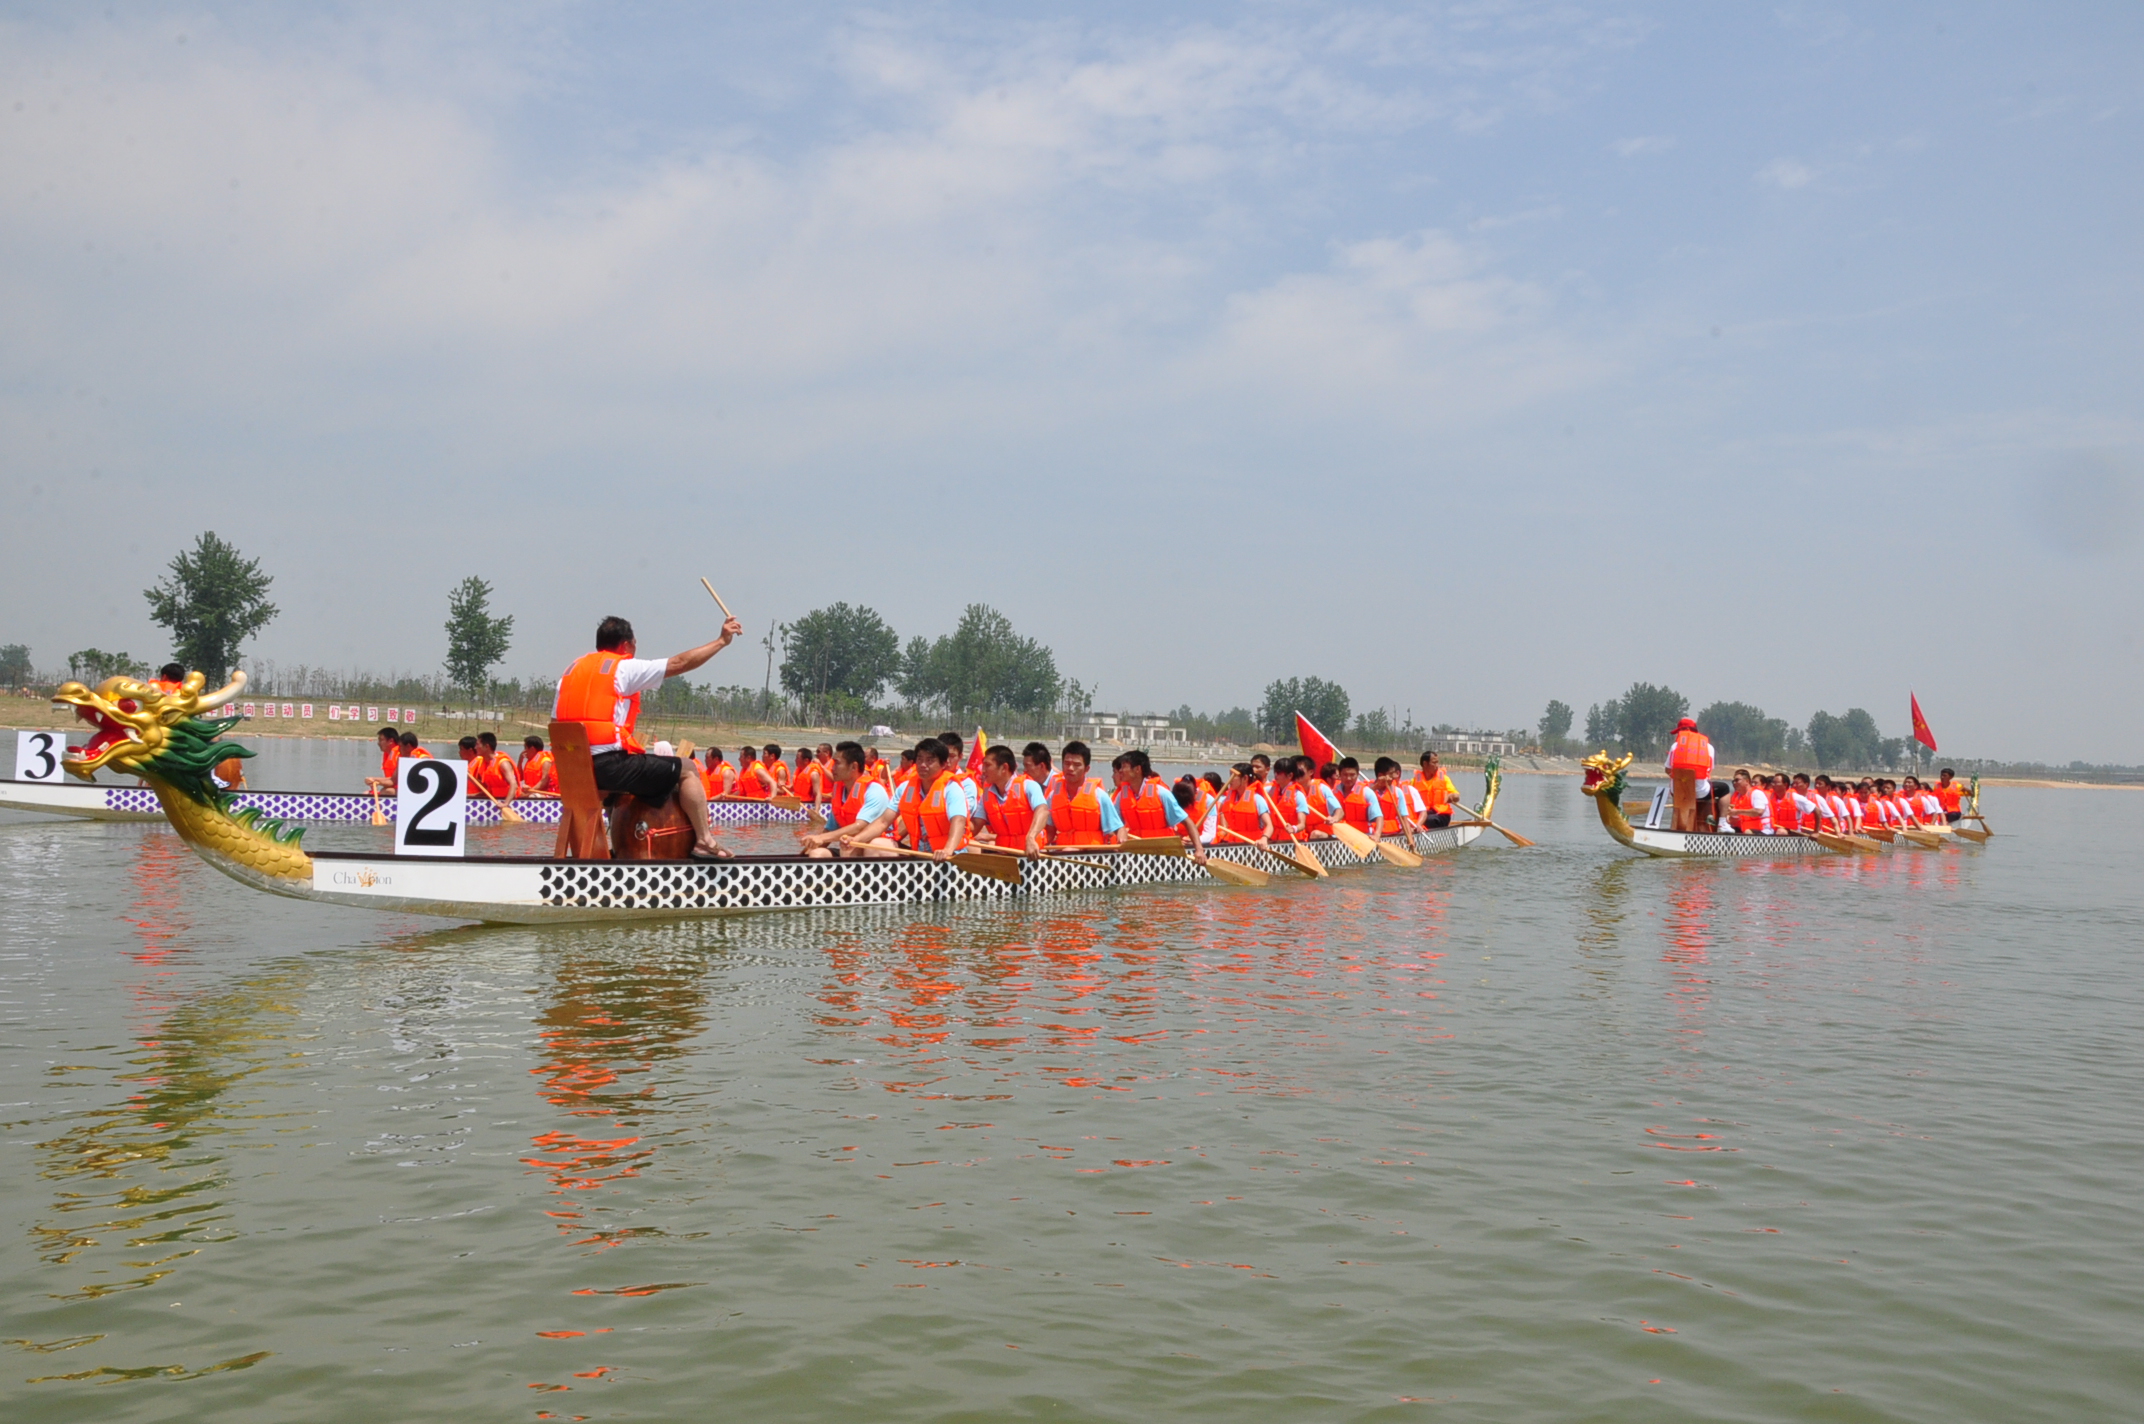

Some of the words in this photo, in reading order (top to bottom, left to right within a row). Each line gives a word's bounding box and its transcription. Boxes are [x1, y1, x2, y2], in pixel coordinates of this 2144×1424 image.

[24, 732, 56, 780] 3
[403, 760, 458, 846] 2
[1649, 787, 1666, 826] 1
